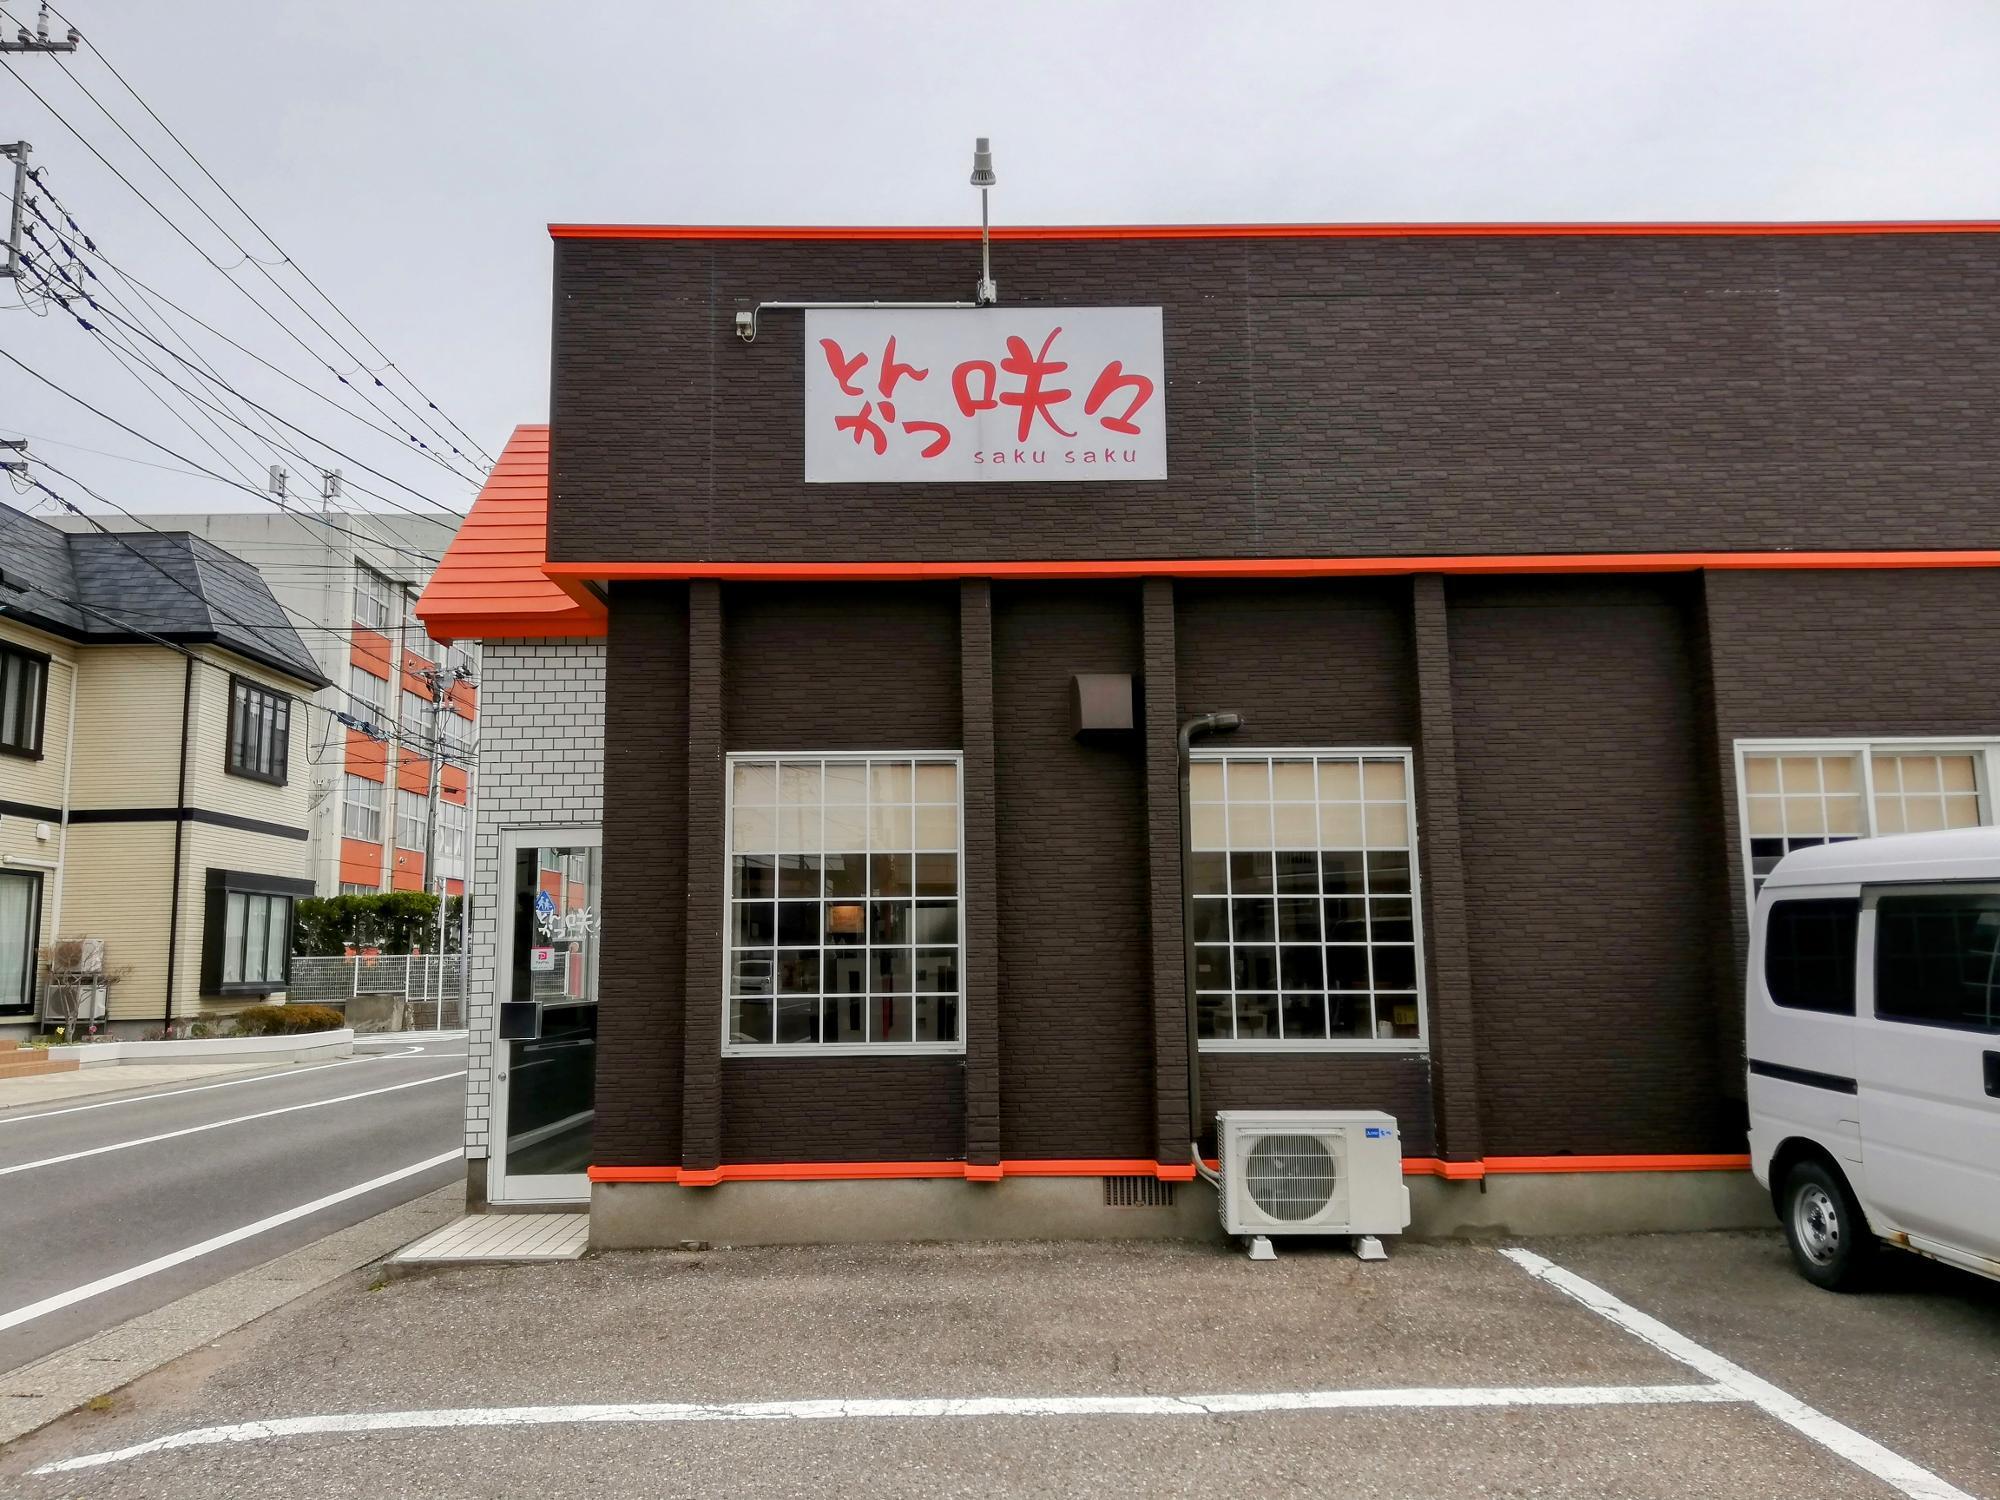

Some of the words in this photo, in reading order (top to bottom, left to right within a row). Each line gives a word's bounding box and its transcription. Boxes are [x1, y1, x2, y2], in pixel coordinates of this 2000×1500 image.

[819, 335, 929, 399] とん
[951, 326, 1154, 443] 咲々
[834, 401, 951, 459] かつ
[974, 448, 1047, 465] saku
[1064, 448, 1137, 464] saku
